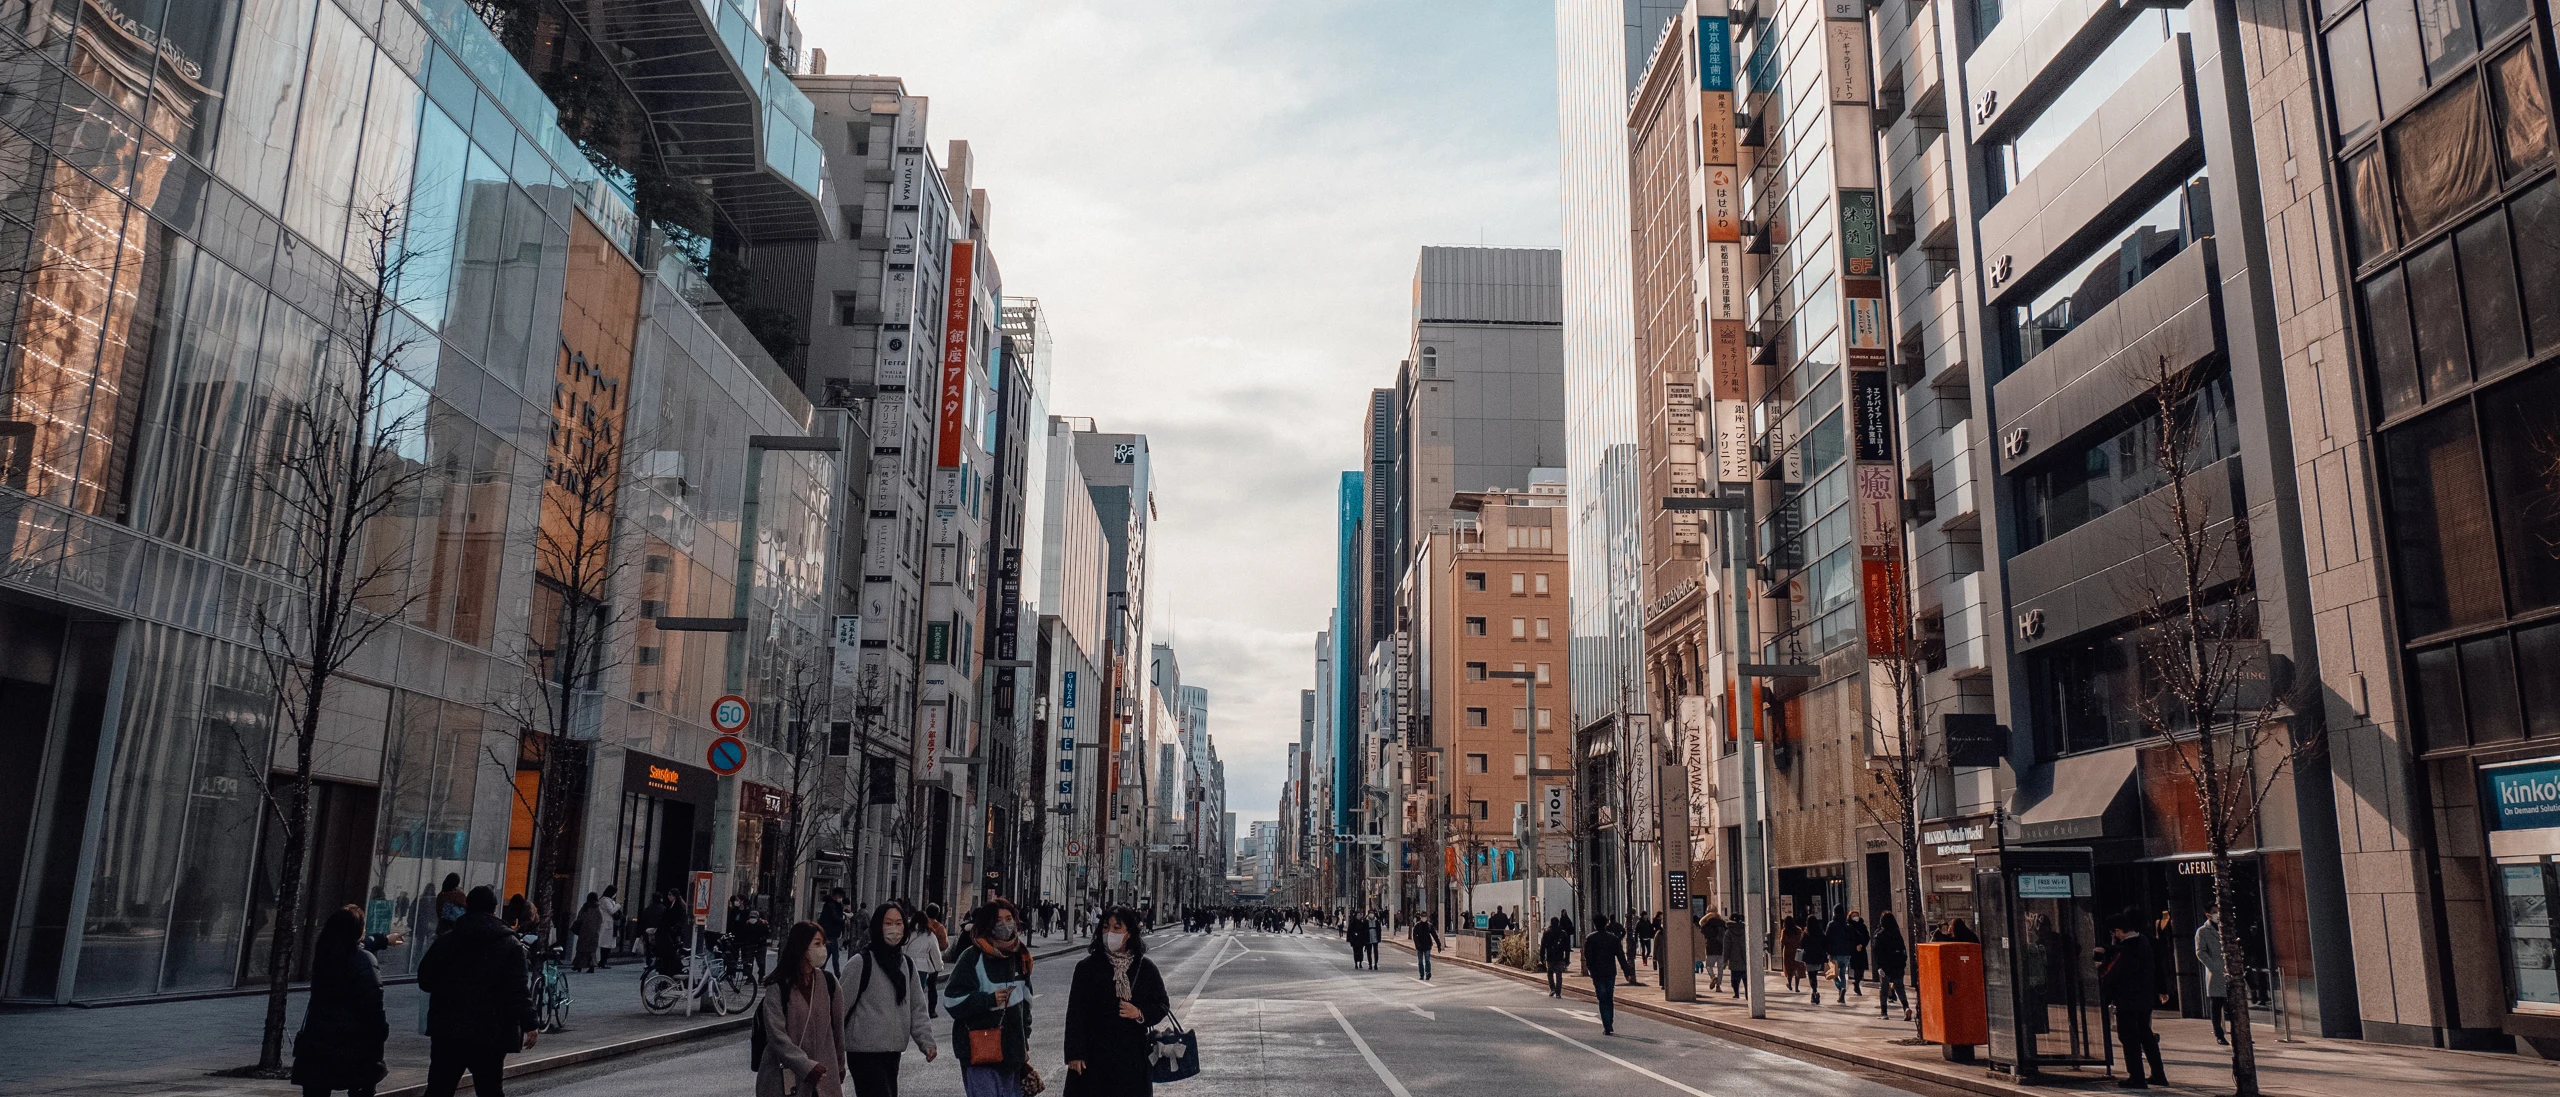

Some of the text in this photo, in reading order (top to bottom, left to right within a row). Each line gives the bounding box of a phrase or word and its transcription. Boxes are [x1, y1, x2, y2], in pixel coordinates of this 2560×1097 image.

[1836, 4, 1851, 14] 8F
[1708, 21, 1722, 87] 東京銀座歯科
[1842, 42, 1853, 100] ギャラリーゴトウ
[1717, 93, 1727, 148] 銀座ファースト
[1710, 123, 1720, 162] 法律事務所
[903, 168, 912, 201] YUTAKA
[1717, 189, 1729, 228] はせがわ
[1860, 195, 1876, 257] マッサージ
[1849, 257, 1873, 274] 5F
[952, 276, 966, 320] 中国名菜
[883, 358, 906, 367] Terra
[944, 328, 966, 433] 銀座アスター
[1721, 354, 1729, 387] クリニック
[1730, 347, 1740, 394] モティーフ銀座
[880, 404, 890, 445] クリニック
[889, 404, 898, 437] オーラル
[1866, 387, 1876, 445] ネイルスクール東京
[1720, 431, 1731, 477] クリニック
[947, 472, 956, 505] 銀座アスター
[1646, 576, 1695, 621] GINZA TANAKA
[719, 705, 742, 723] 50
[1689, 726, 1702, 794] TANIZAWA
[1550, 788, 1561, 829] POLA
[2504, 807, 2513, 816] On
[2513, 804, 2539, 815] Demand
[986, 871, 1000, 879] UGG
[2037, 878, 2067, 886] FREE Wi-Fi
